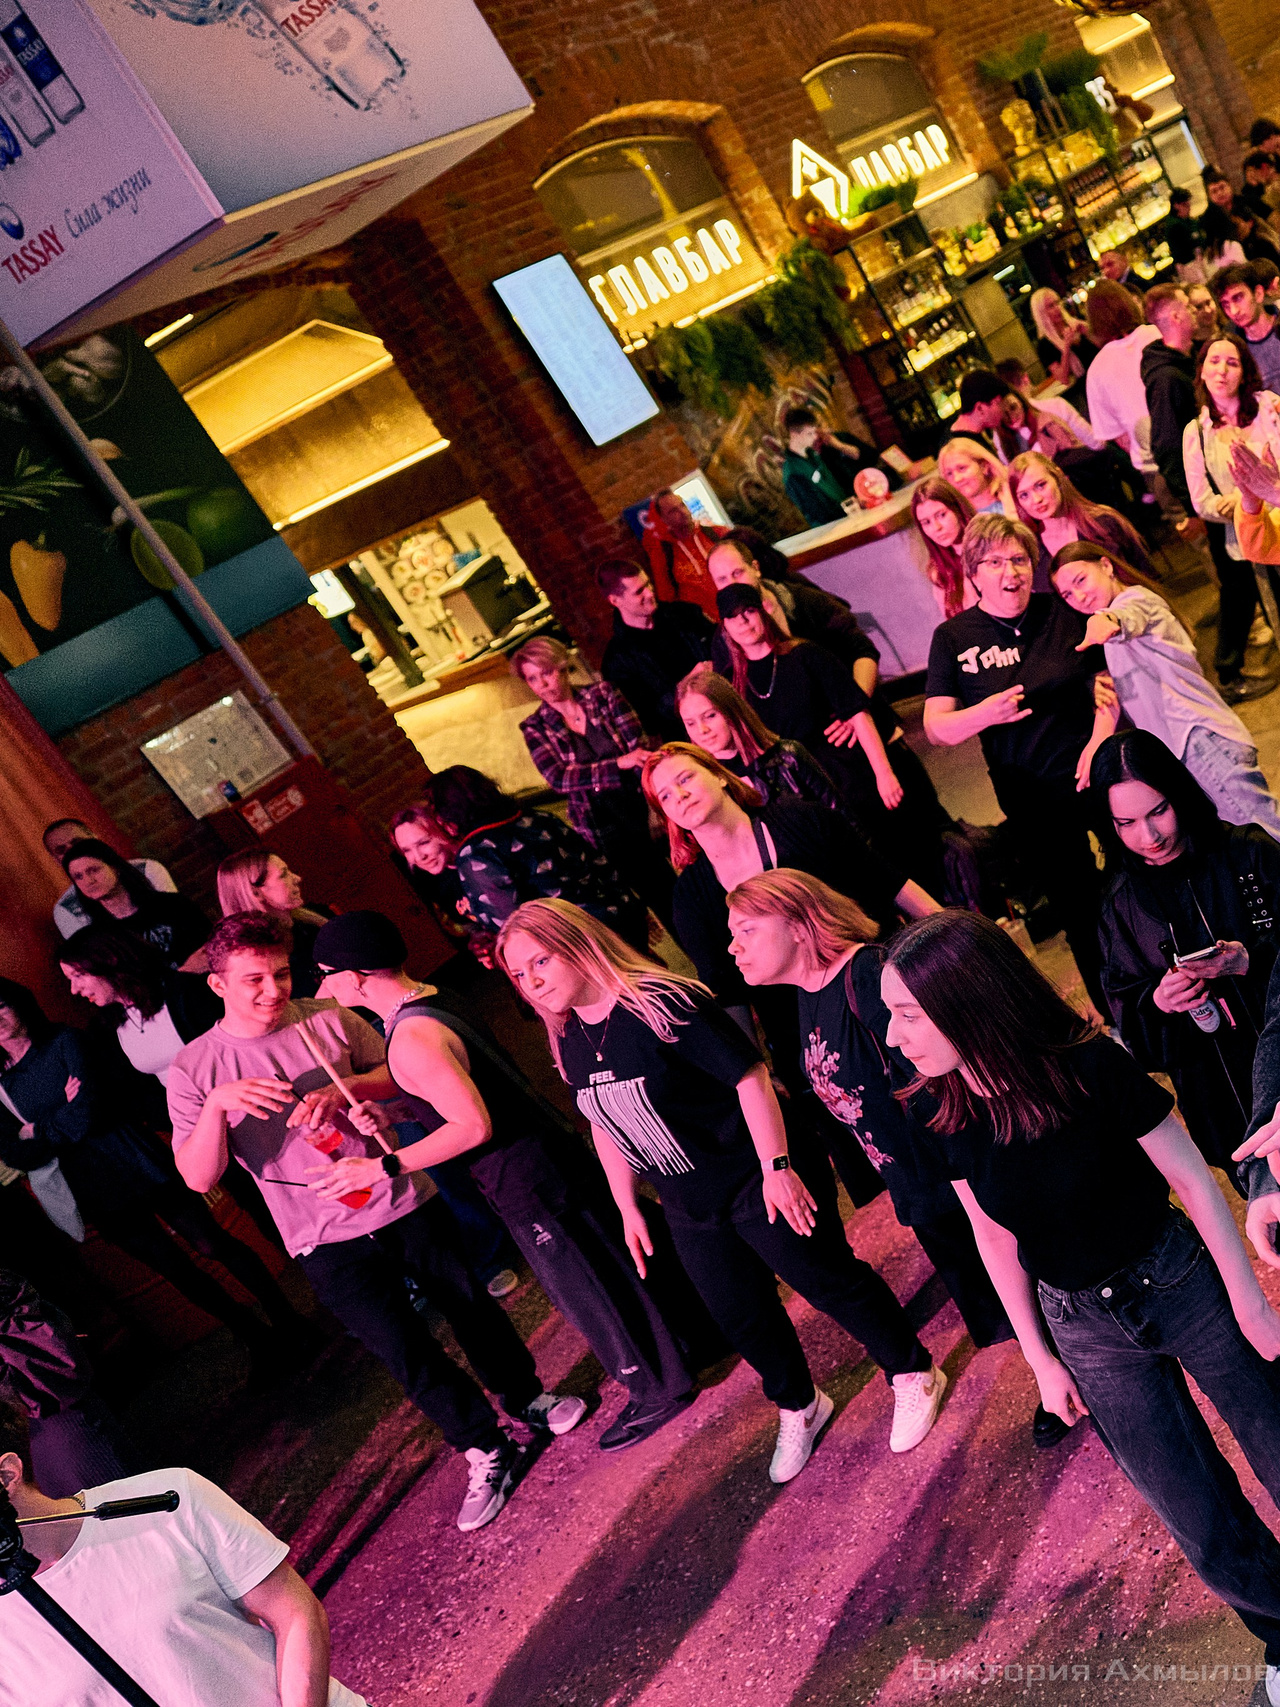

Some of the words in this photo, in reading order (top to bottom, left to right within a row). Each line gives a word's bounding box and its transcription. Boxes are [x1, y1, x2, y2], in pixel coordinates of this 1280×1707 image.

[850, 124, 950, 189] ЛАВБАР
[1, 225, 65, 284] TASSAY
[64, 208, 103, 239] Сила
[102, 167, 152, 215] жизни
[588, 219, 743, 324] ГЛАВБАР
[957, 645, 1021, 674] John
[589, 1070, 617, 1086] FEEL
